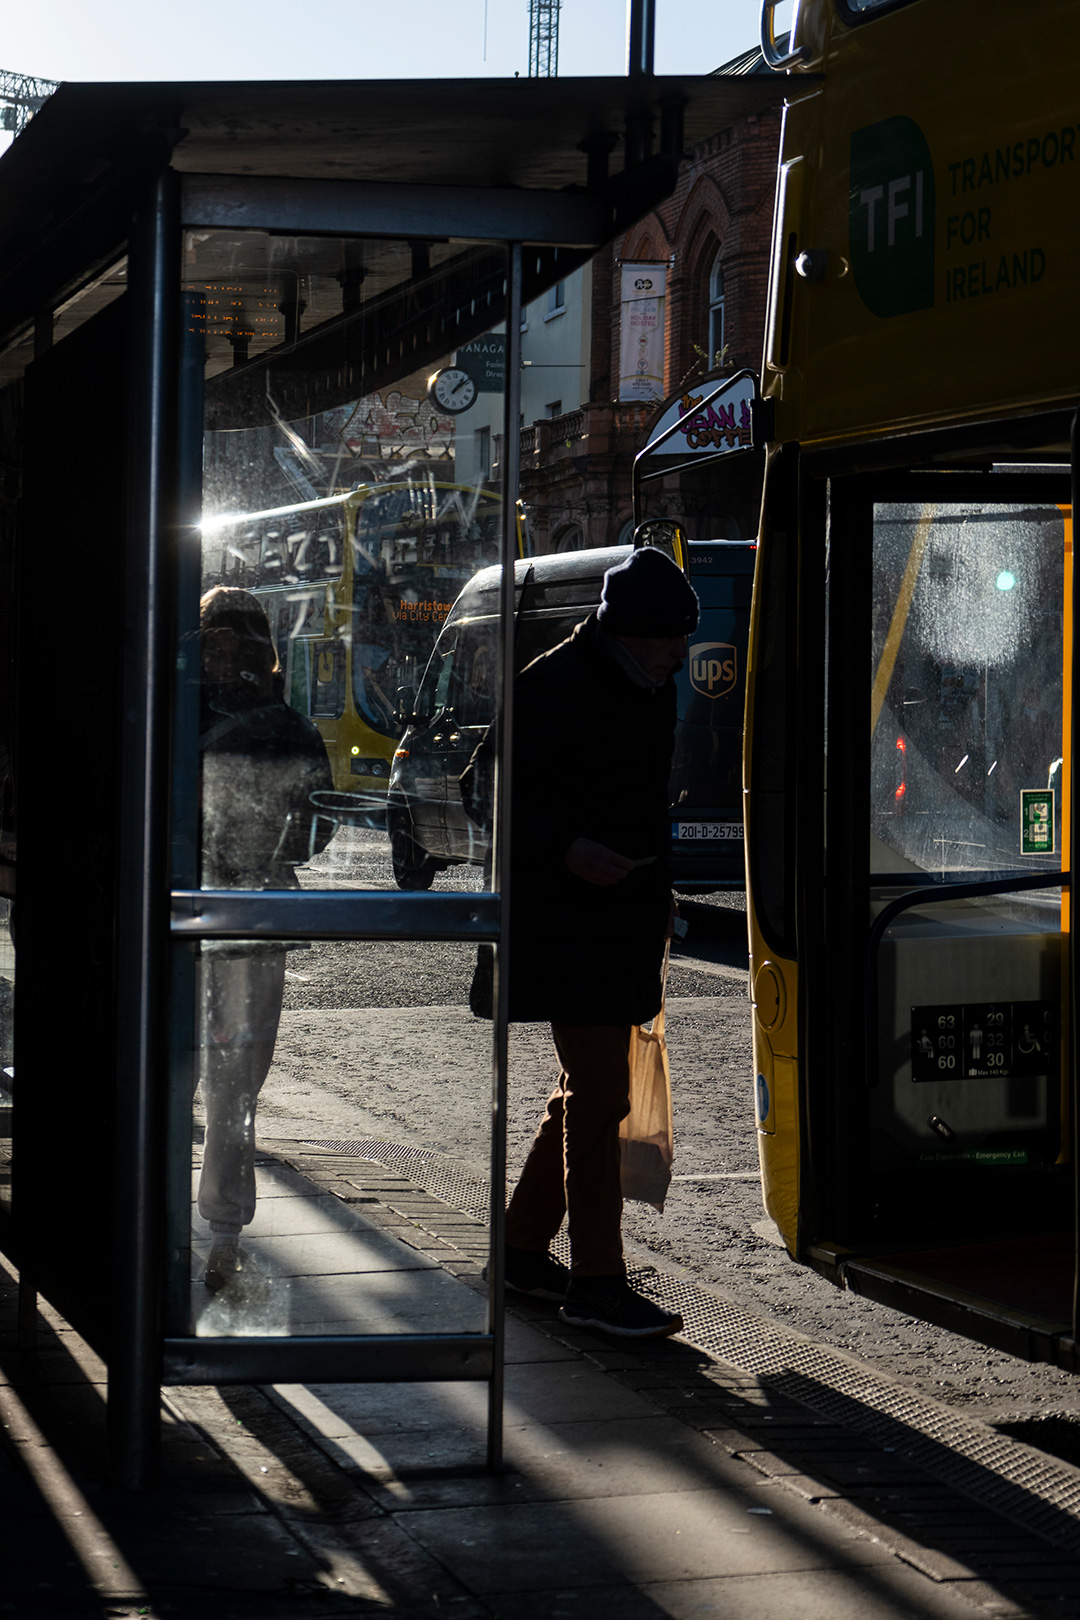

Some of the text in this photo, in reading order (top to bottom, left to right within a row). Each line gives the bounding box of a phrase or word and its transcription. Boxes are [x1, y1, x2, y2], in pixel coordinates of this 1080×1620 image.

[860, 170, 923, 253] TFI
[947, 206, 991, 250] FOR
[947, 247, 1045, 303] IRELAND
[400, 599, 454, 612] Harristow
[392, 610, 408, 621] via
[410, 610, 430, 622] City
[693, 659, 735, 690] ups
[938, 1015, 956, 1030] 63
[987, 1012, 1004, 1027] 29
[938, 1035, 956, 1049] 60
[987, 1032, 1004, 1047] 32
[938, 1055, 956, 1069] 60
[987, 1052, 1004, 1067] 30
[976, 1151, 1011, 1159] Emergency
